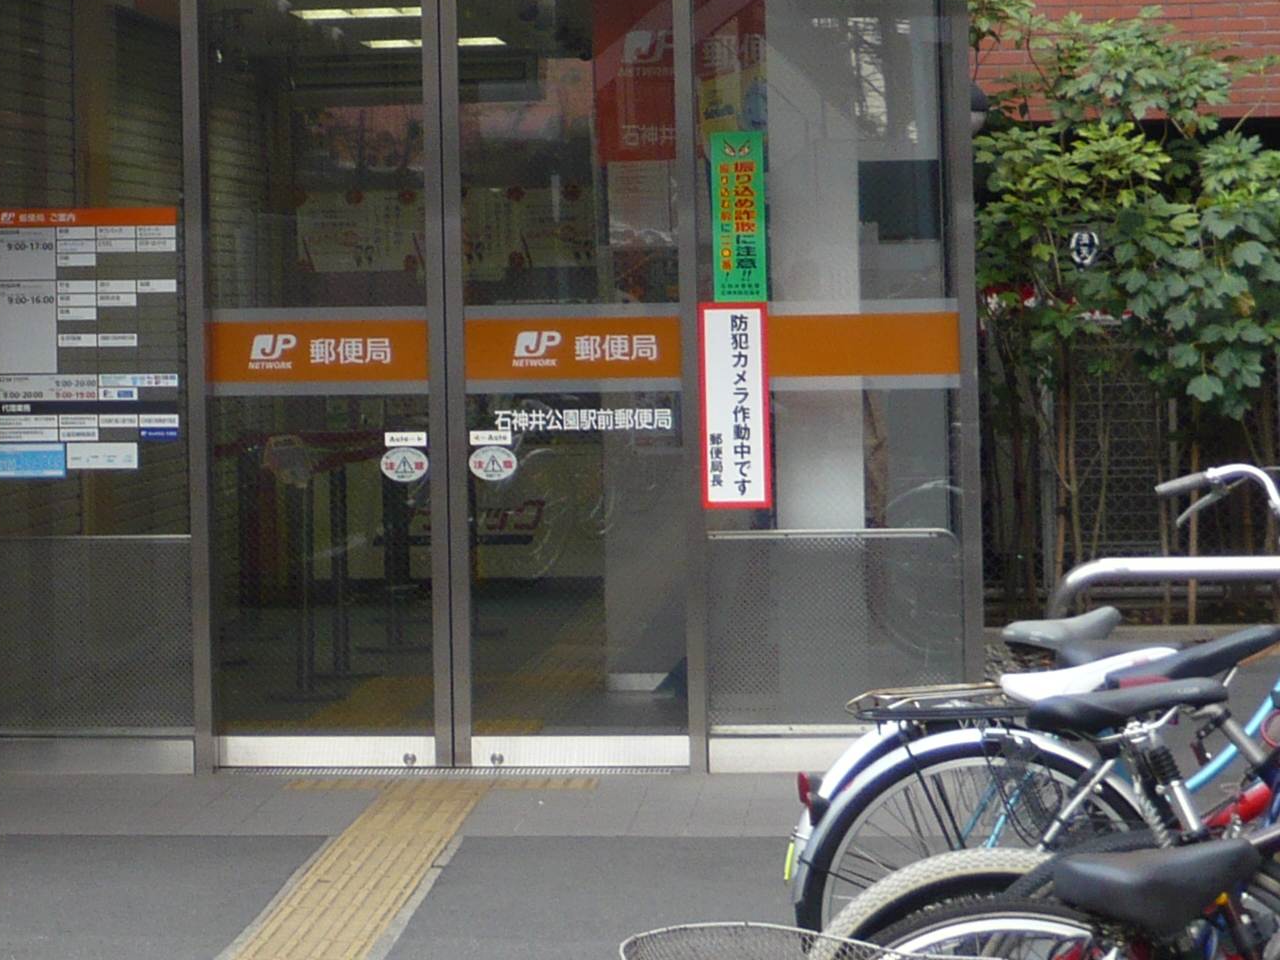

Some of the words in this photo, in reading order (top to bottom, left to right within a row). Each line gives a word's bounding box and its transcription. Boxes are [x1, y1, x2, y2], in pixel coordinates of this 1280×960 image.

[250, 333, 297, 360] JP
[309, 337, 392, 365] 郵便局
[514, 331, 562, 357] JP
[574, 335, 658, 362] 郵便局
[248, 361, 293, 370] NETWORK
[512, 359, 558, 368] NETWORK
[493, 408, 673, 431] 石神井公園駅前郵便局
[730, 314, 752, 497] 防犯カメラ作動中です
[709, 432, 724, 488] 郵便局長
